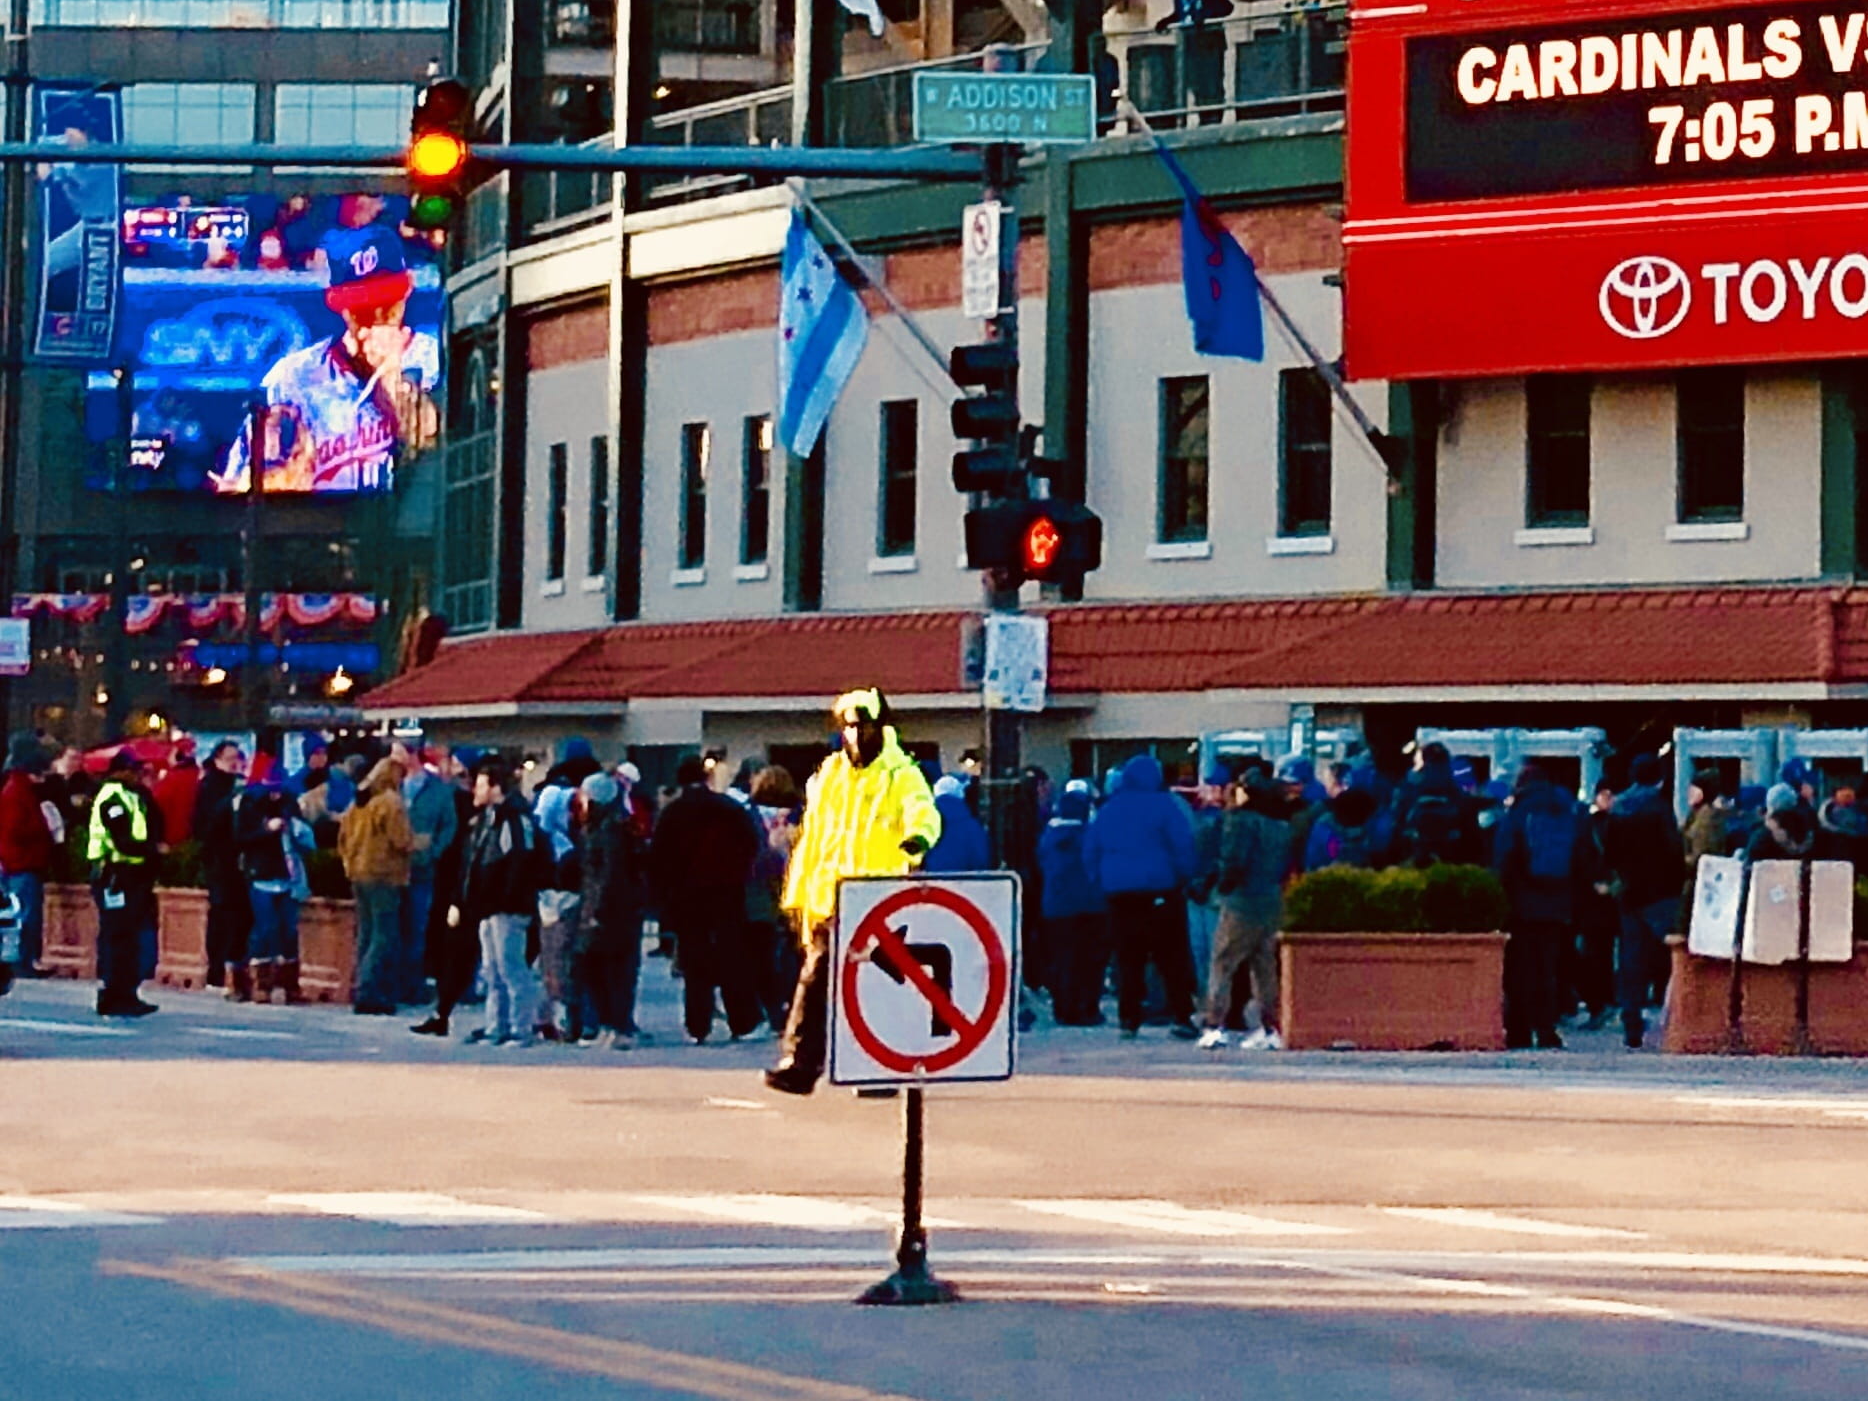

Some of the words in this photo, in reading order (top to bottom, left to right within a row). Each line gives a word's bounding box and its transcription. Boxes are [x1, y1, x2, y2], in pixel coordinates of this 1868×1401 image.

[1457, 19, 1801, 105] CARDINALS
[948, 83, 1057, 110] ADDISON
[1064, 88, 1087, 106] ST
[965, 113, 1021, 132] 3600
[1648, 98, 1775, 165] 7:05
